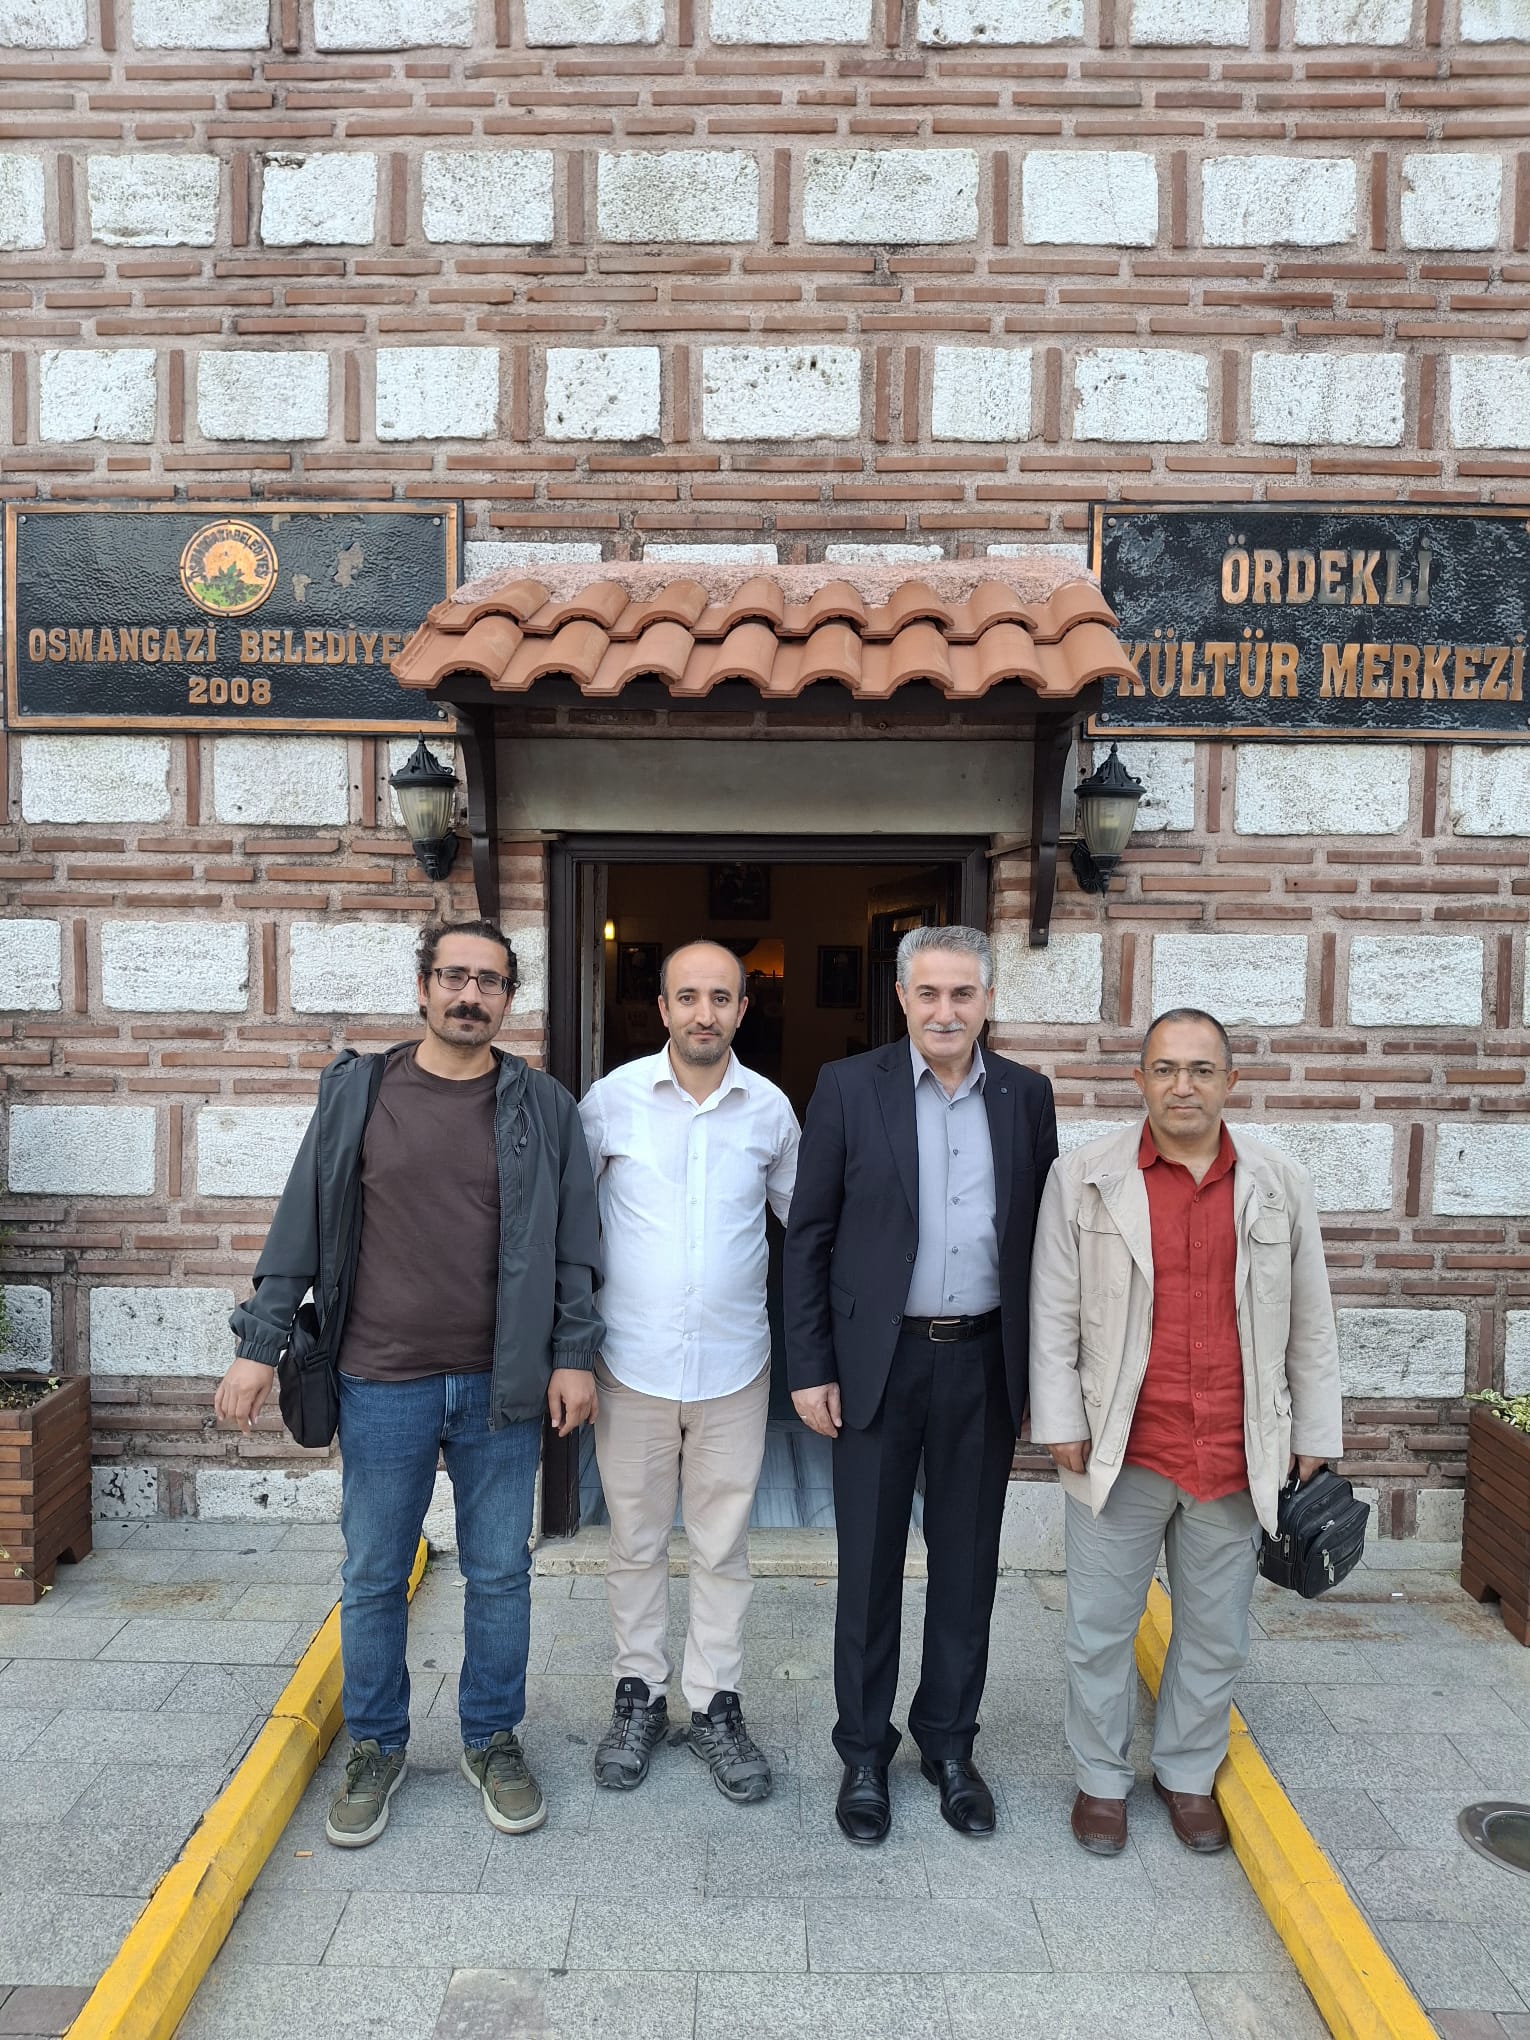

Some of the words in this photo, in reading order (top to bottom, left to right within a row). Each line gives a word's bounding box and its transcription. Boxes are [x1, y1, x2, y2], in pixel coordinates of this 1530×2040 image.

[1221, 534, 1433, 606] ÖRDEKLİ
[28, 621, 217, 663] OSMANGAZİ
[239, 623, 414, 665] BELEDİYE
[1116, 626, 1299, 698] KÜLTÜR
[1319, 634, 1525, 701] MERKEZİ
[188, 677, 271, 705] 2008
